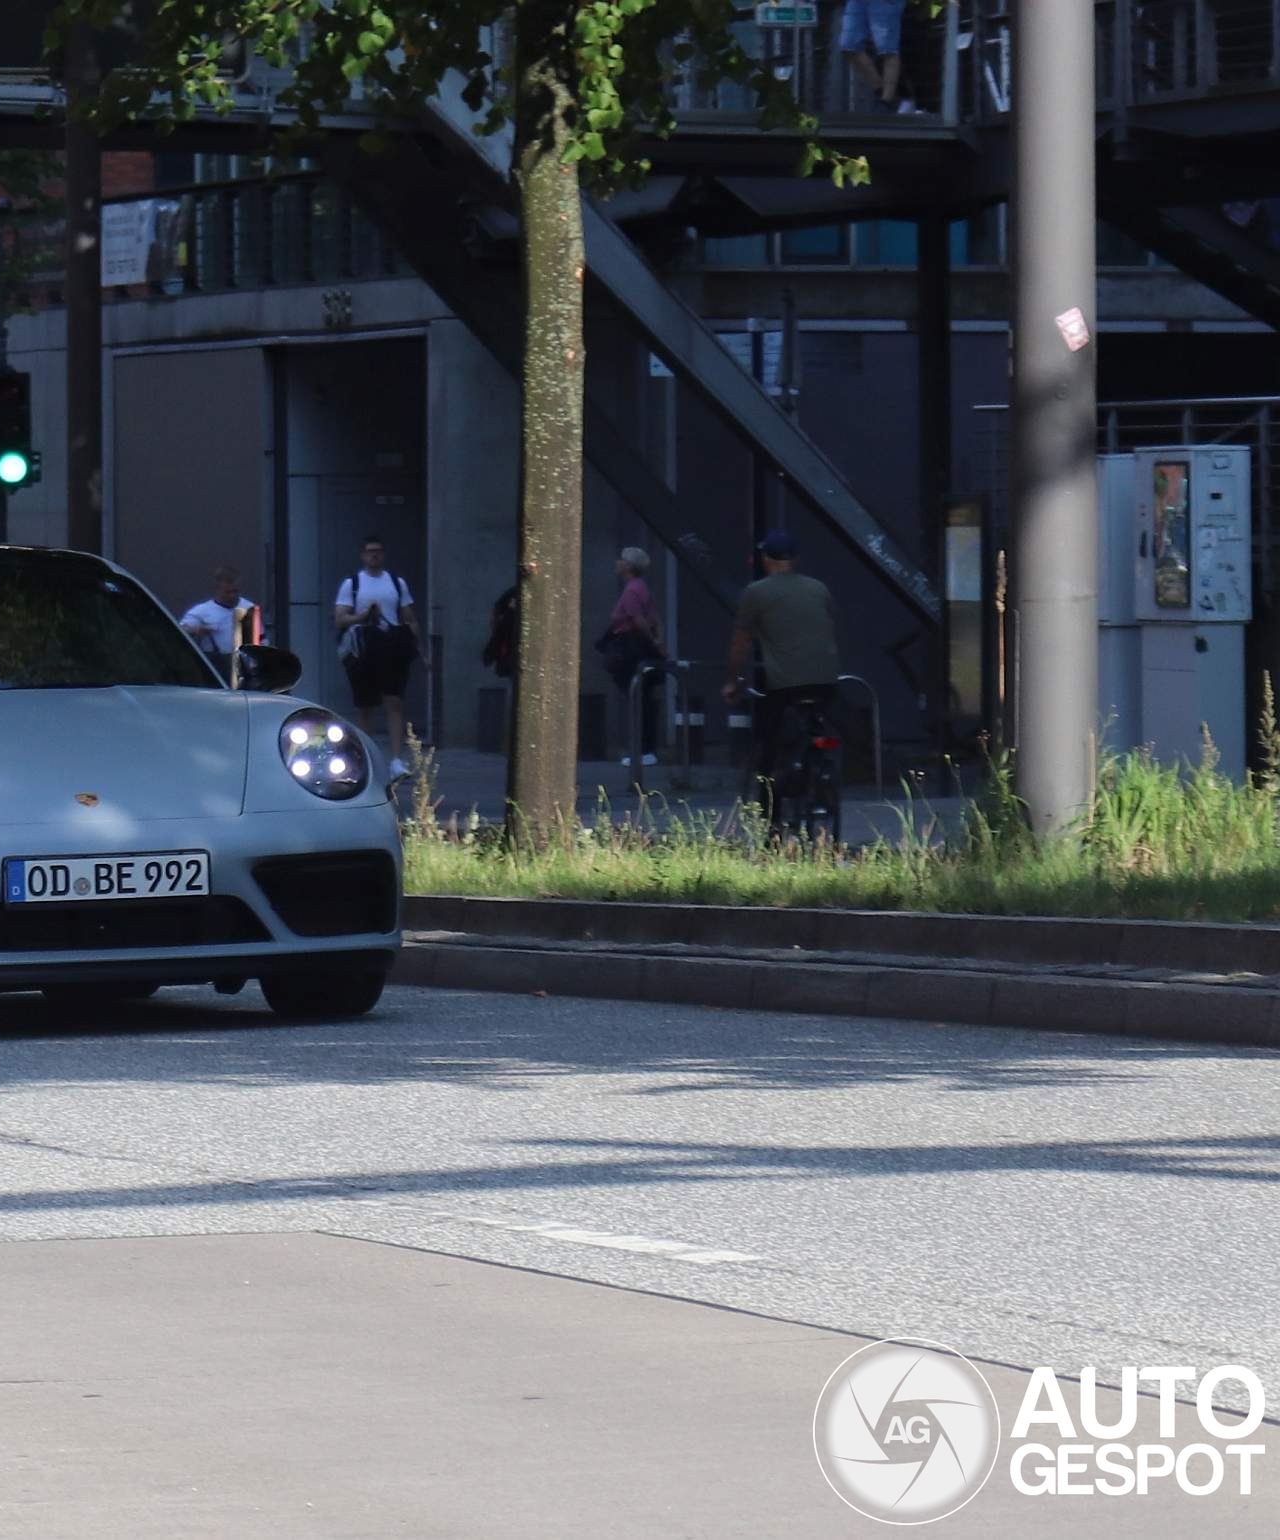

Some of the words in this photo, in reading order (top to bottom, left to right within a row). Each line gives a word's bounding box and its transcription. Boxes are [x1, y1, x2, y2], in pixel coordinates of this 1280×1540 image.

[12, 886, 21, 896] D
[27, 864, 71, 897] OD
[94, 862, 137, 895] BE
[144, 859, 203, 893] 992
